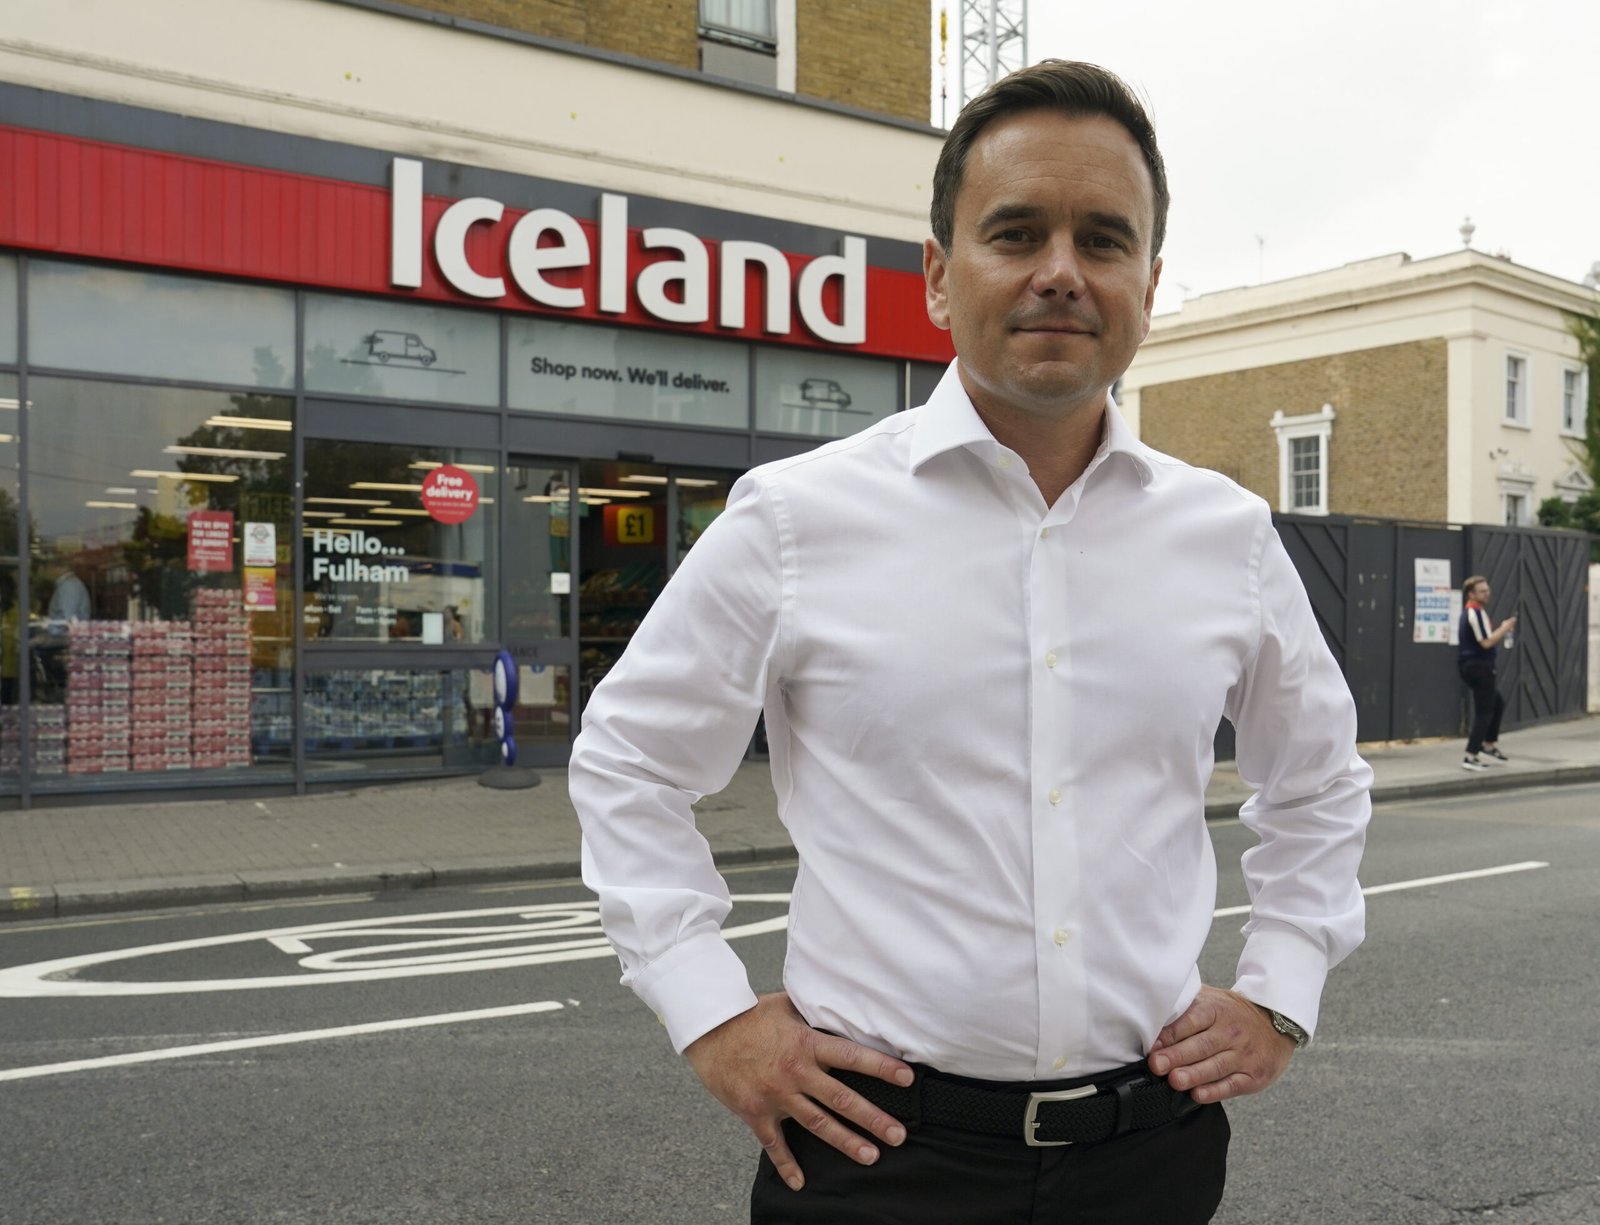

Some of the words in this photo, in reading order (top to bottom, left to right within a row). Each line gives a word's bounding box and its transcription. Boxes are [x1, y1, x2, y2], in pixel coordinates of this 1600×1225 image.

[389, 156, 867, 345] Iceland
[530, 355, 577, 381] Shop
[581, 365, 623, 383] now.
[627, 366, 669, 387] We'll
[672, 371, 731, 394] deliver.
[436, 473, 463, 487] Free
[425, 485, 474, 502] delivery
[625, 514, 646, 537] £1
[313, 529, 406, 555] Hello...
[313, 557, 409, 583] Fulham
